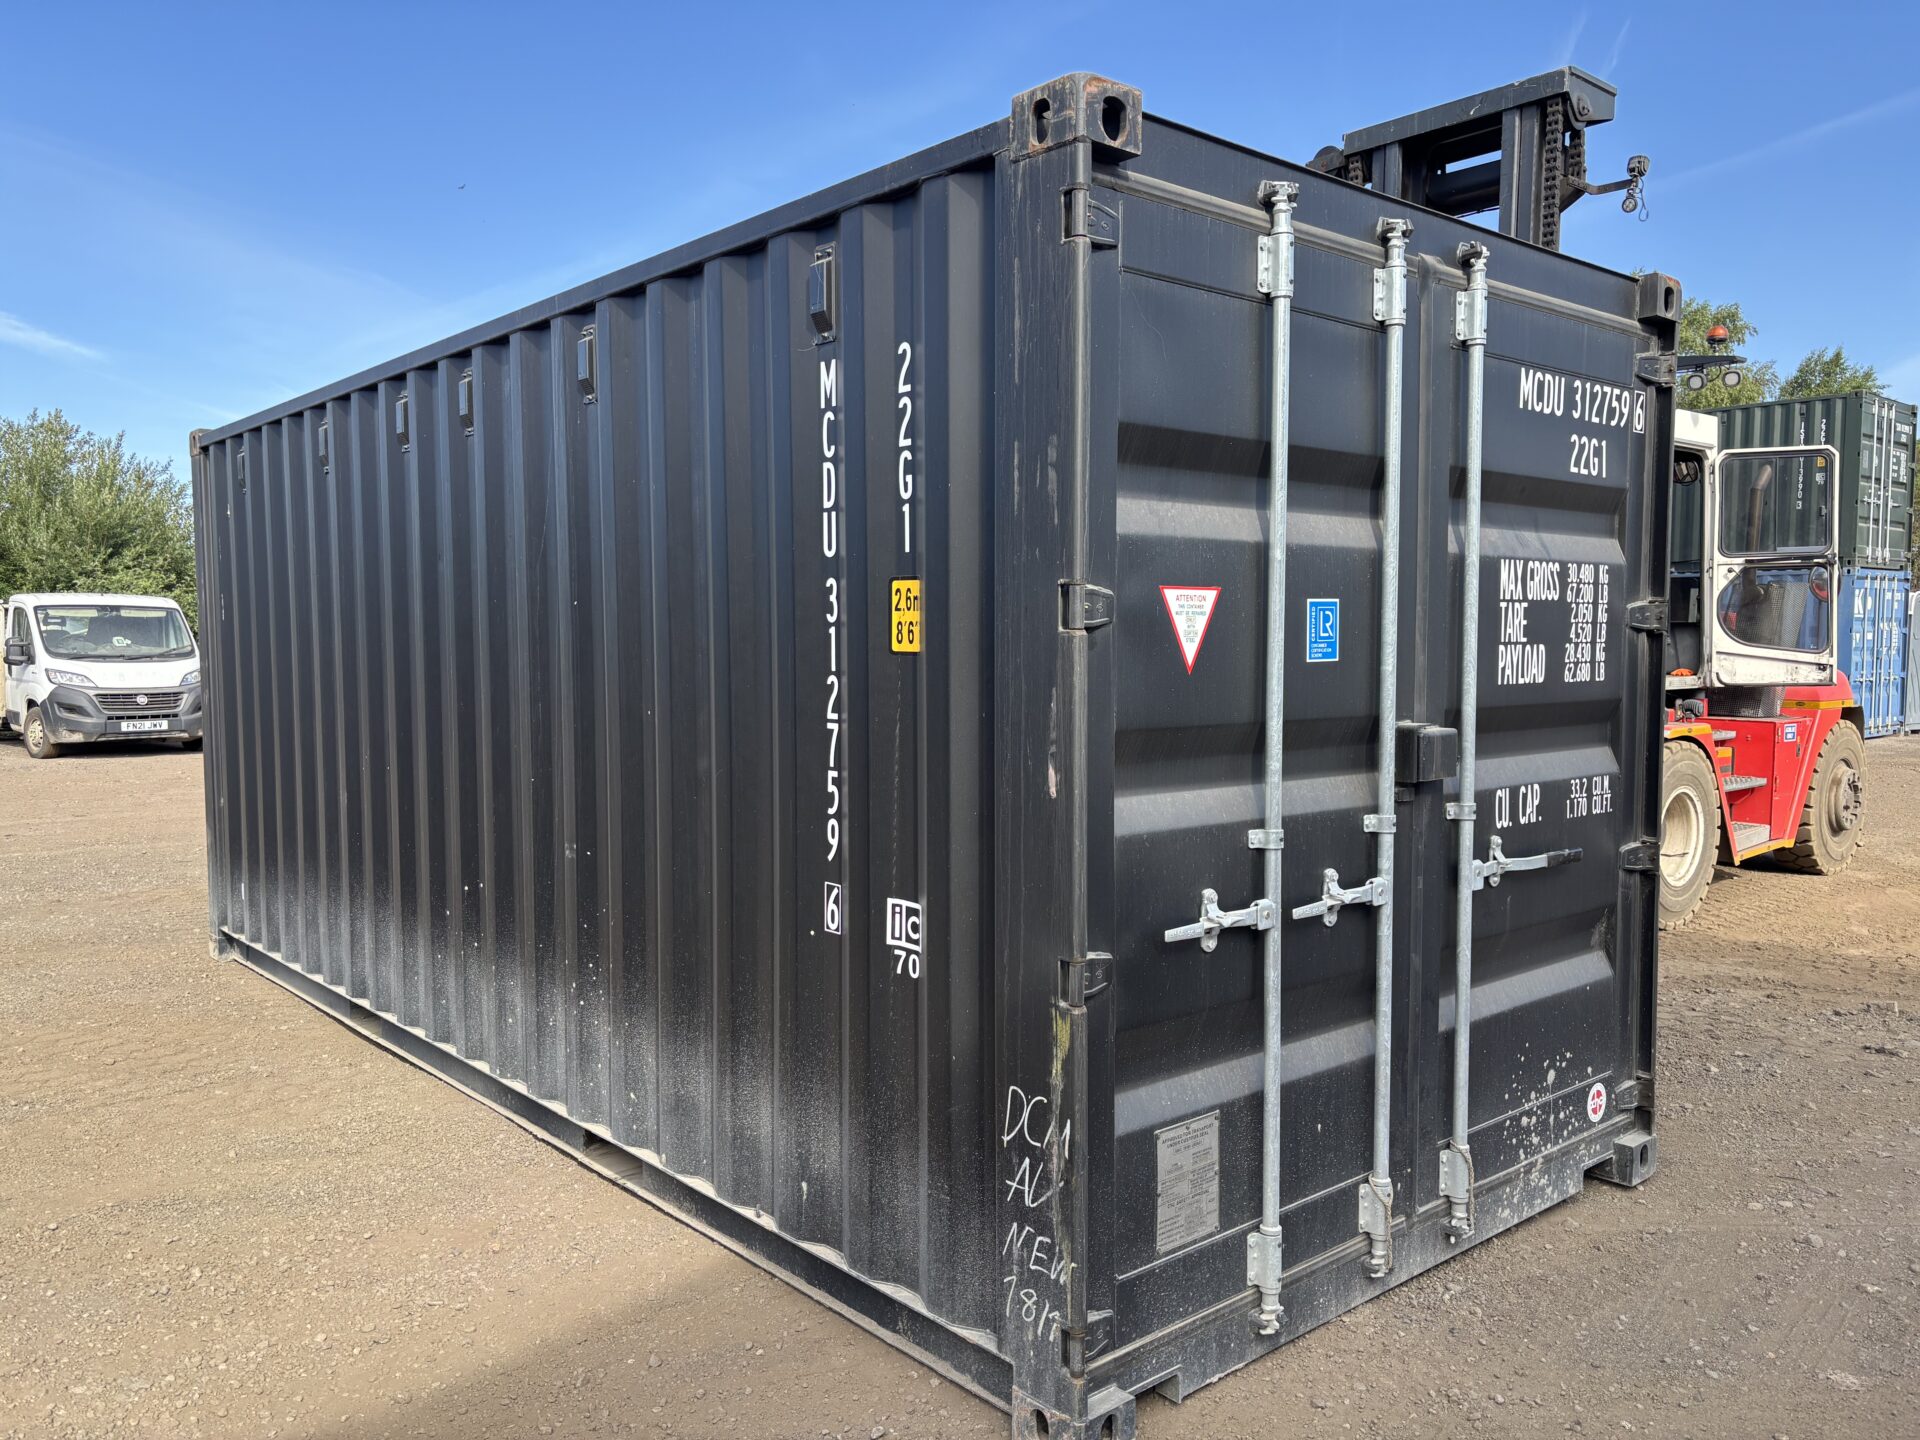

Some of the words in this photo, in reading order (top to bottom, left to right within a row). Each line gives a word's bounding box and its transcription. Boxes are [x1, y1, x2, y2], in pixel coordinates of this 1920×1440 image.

[1519, 367, 1566, 417] MCDU
[1572, 379, 1630, 428] 312759
[1635, 394, 1644, 431] 6
[820, 359, 837, 558] MCDU
[898, 342, 913, 552] 22G1
[1570, 434, 1607, 479] 22G1
[1175, 594, 1207, 602] ATTENTION
[1500, 558, 1524, 600] MAX
[1526, 560, 1560, 601] GROSS
[1567, 563, 1594, 583] 30.480
[1599, 564, 1609, 584] KG
[1566, 583, 1594, 603] 67.200
[1598, 584, 1608, 603] LB
[1500, 602, 1528, 642] TARE
[1570, 603, 1593, 623] 2.050
[1598, 603, 1608, 623] KG
[1570, 623, 1592, 642] 4.520
[1596, 623, 1607, 642] LB
[1497, 643, 1546, 685] PAYLOAD
[1564, 643, 1591, 663] 28.430
[1595, 643, 1606, 662] KG
[1564, 662, 1591, 682] 62.680
[1595, 662, 1605, 681] LB
[126, 722, 146, 730] FN21
[147, 721, 163, 729] JWV
[826, 577, 840, 862] 312759
[1495, 787, 1512, 829] CU.
[1519, 783, 1542, 825] CAP.
[1570, 778, 1588, 798] 33.2
[1592, 775, 1611, 795] CU.M.
[1566, 797, 1588, 819] 1.170
[1591, 793, 1613, 814] CU.FT.
[826, 887, 840, 930] 6
[894, 949, 920, 979] 70
